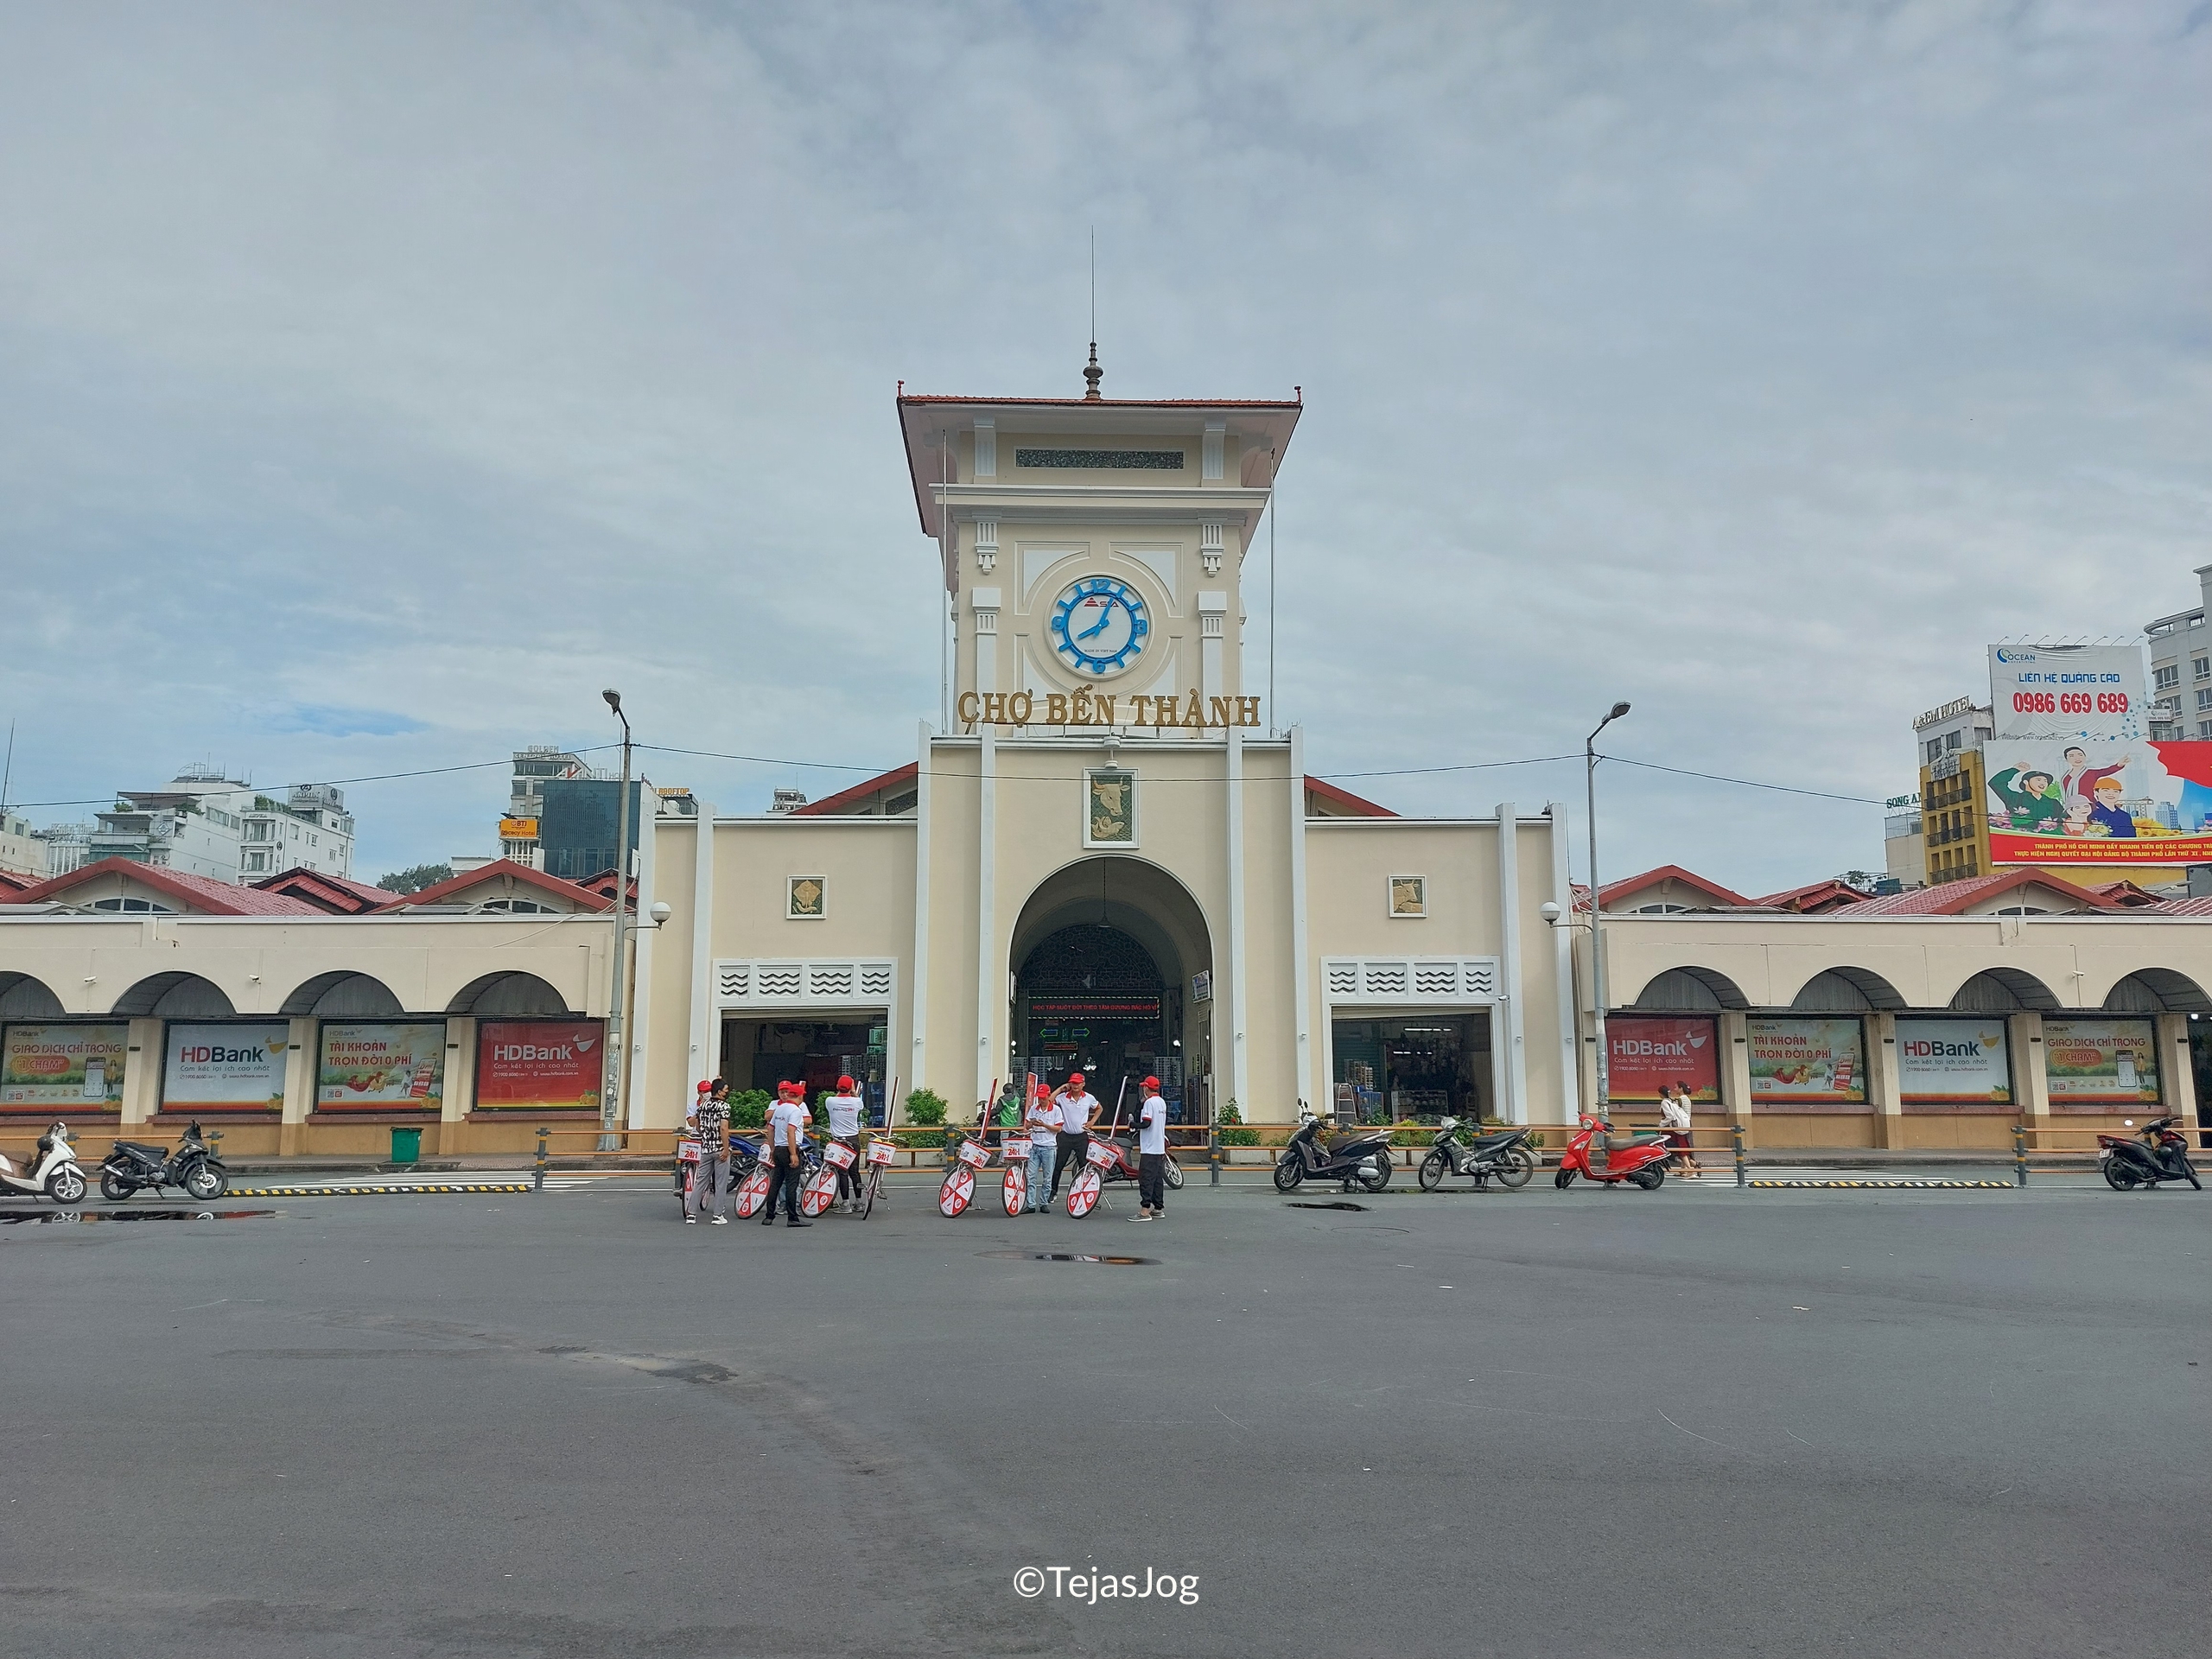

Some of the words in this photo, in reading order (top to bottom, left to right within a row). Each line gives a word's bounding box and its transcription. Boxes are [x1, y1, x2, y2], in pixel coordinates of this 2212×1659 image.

[1090, 579, 1111, 594] 12
[1092, 658, 1106, 674] 6
[958, 688, 1034, 728] CHỢ
[1046, 683, 1116, 725] BẾN
[1129, 688, 1262, 727] THÀNH
[2013, 692, 2056, 714] 0986
[2060, 692, 2092, 714] 669
[2097, 692, 2128, 714] 689
[1886, 795, 1910, 809] SONG
[329, 1040, 344, 1052] TÀI
[347, 1039, 386, 1052] KHOẢN
[1753, 1034, 1768, 1045] TÀI
[1770, 1033, 1807, 1045] KHOẢN
[2048, 1038, 2072, 1047] GIAO
[2075, 1038, 2095, 1049] DỊCH
[2097, 1036, 2111, 1046] CHỈ
[2113, 1038, 2145, 1047] TRONG
[12, 1044, 40, 1053] GIAO
[41, 1044, 66, 1055] DỊCH
[67, 1041, 84, 1053] CHỈ
[86, 1044, 122, 1053] TRONG
[181, 1046, 264, 1062] HDBank
[493, 1045, 573, 1061] HDBank
[1612, 1039, 1688, 1055] HDBank
[1754, 1049, 1783, 1060] TRỌN
[1784, 1048, 1805, 1058] ĐỜI
[1815, 1048, 1832, 1058] PHÍ
[1904, 1040, 1980, 1056] HDBank
[328, 1057, 359, 1067] TRỌN
[361, 1054, 382, 1065] ĐỜI
[394, 1053, 412, 1065] PHÍ
[684, 1150, 698, 1159] 24H
[876, 1152, 890, 1162] 24H
[973, 1156, 985, 1166] 24H
